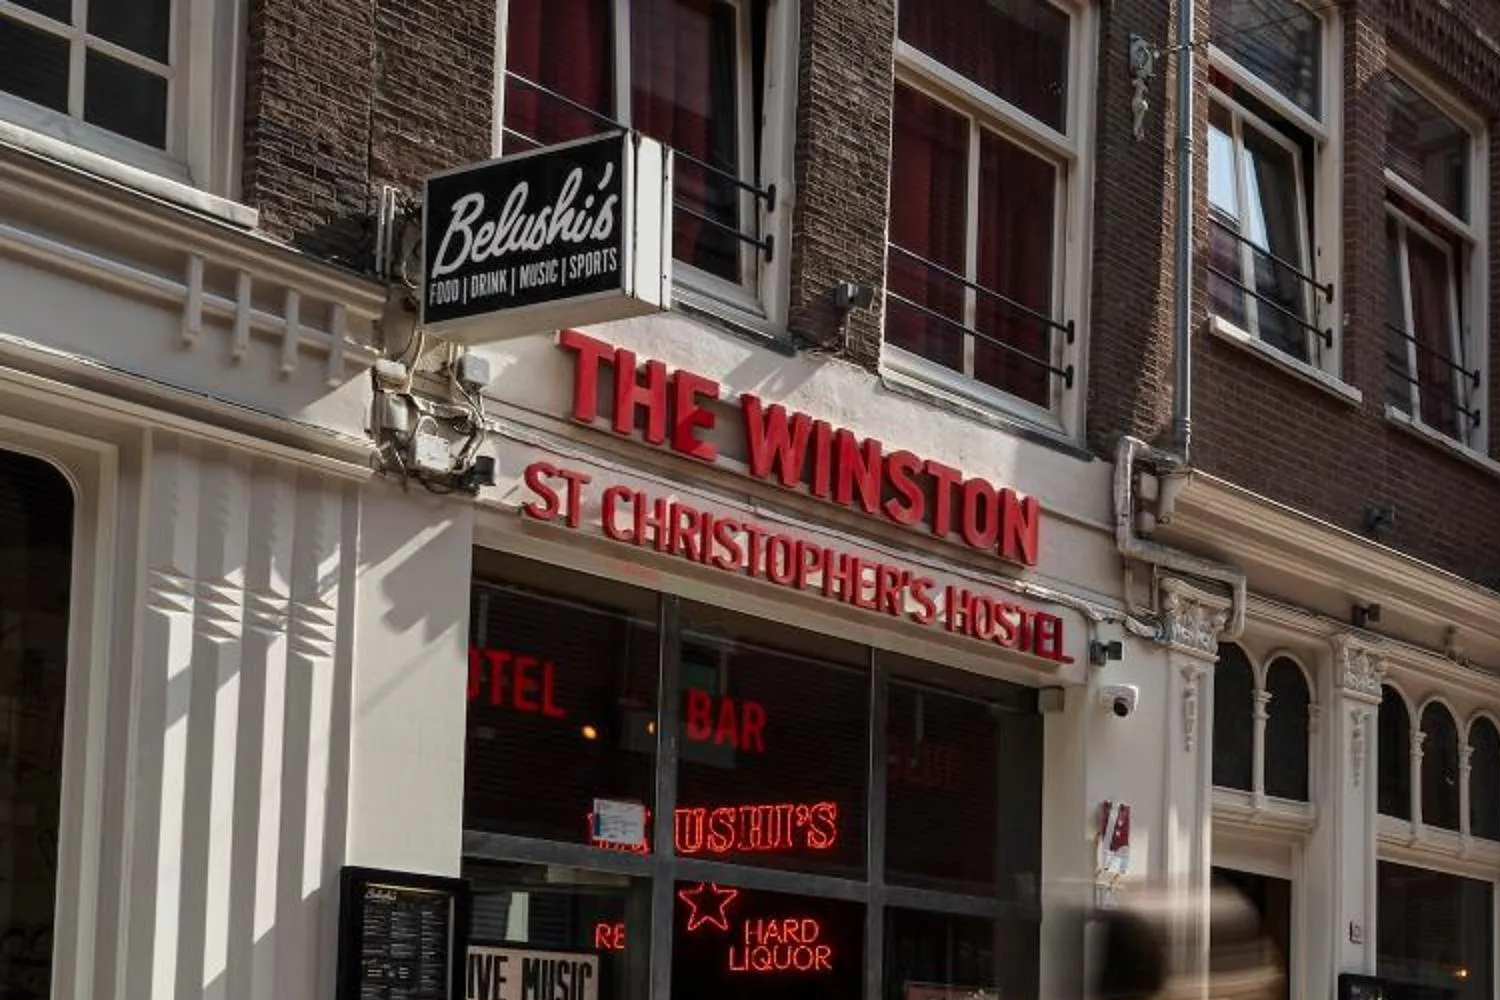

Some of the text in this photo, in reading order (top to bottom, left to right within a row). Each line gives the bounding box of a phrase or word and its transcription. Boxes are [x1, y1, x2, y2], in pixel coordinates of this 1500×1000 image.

[432, 161, 619, 278] Belushi's
[429, 247, 618, 307] FOOD DRINK MUSIC SPORTS
[556, 330, 1040, 567] THE WINSTON
[522, 461, 1075, 666] ST CHRISTOPHER'S HOSTEL
[685, 687, 768, 755] BAR
[728, 944, 833, 972] LIQUOR
[744, 918, 820, 945] HARD
